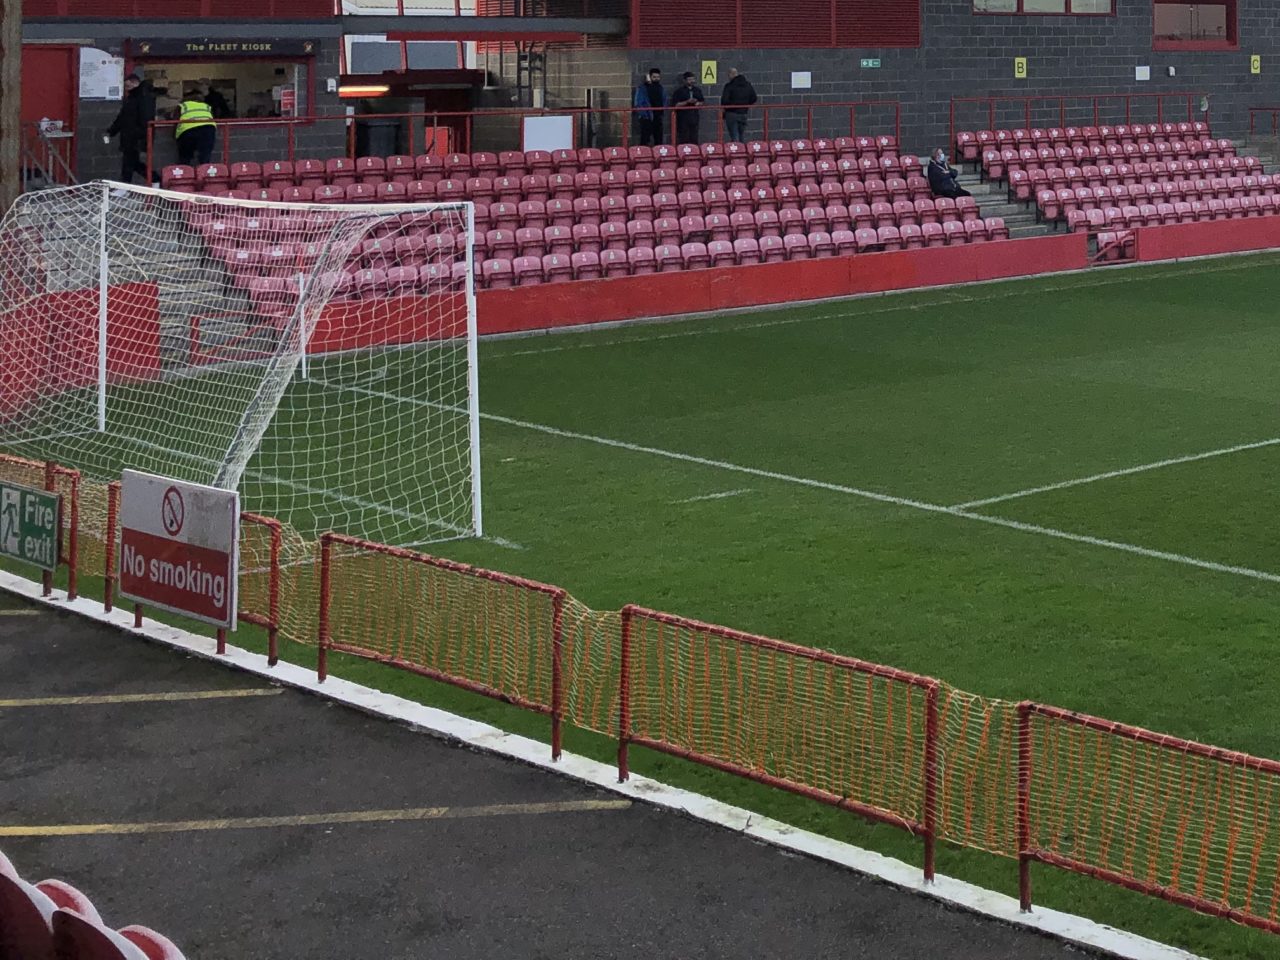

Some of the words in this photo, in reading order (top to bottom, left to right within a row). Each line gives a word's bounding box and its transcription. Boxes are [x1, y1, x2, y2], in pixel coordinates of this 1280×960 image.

[186, 43, 205, 51] The
[208, 43, 239, 51] FLEET
[241, 43, 272, 51] KIOSK
[1016, 61, 1025, 74] B
[1252, 59, 1259, 70] C
[703, 65, 715, 79] A
[25, 494, 54, 530] Fire
[24, 533, 52, 565] exit
[123, 543, 145, 578] No
[149, 558, 225, 608] smoking
